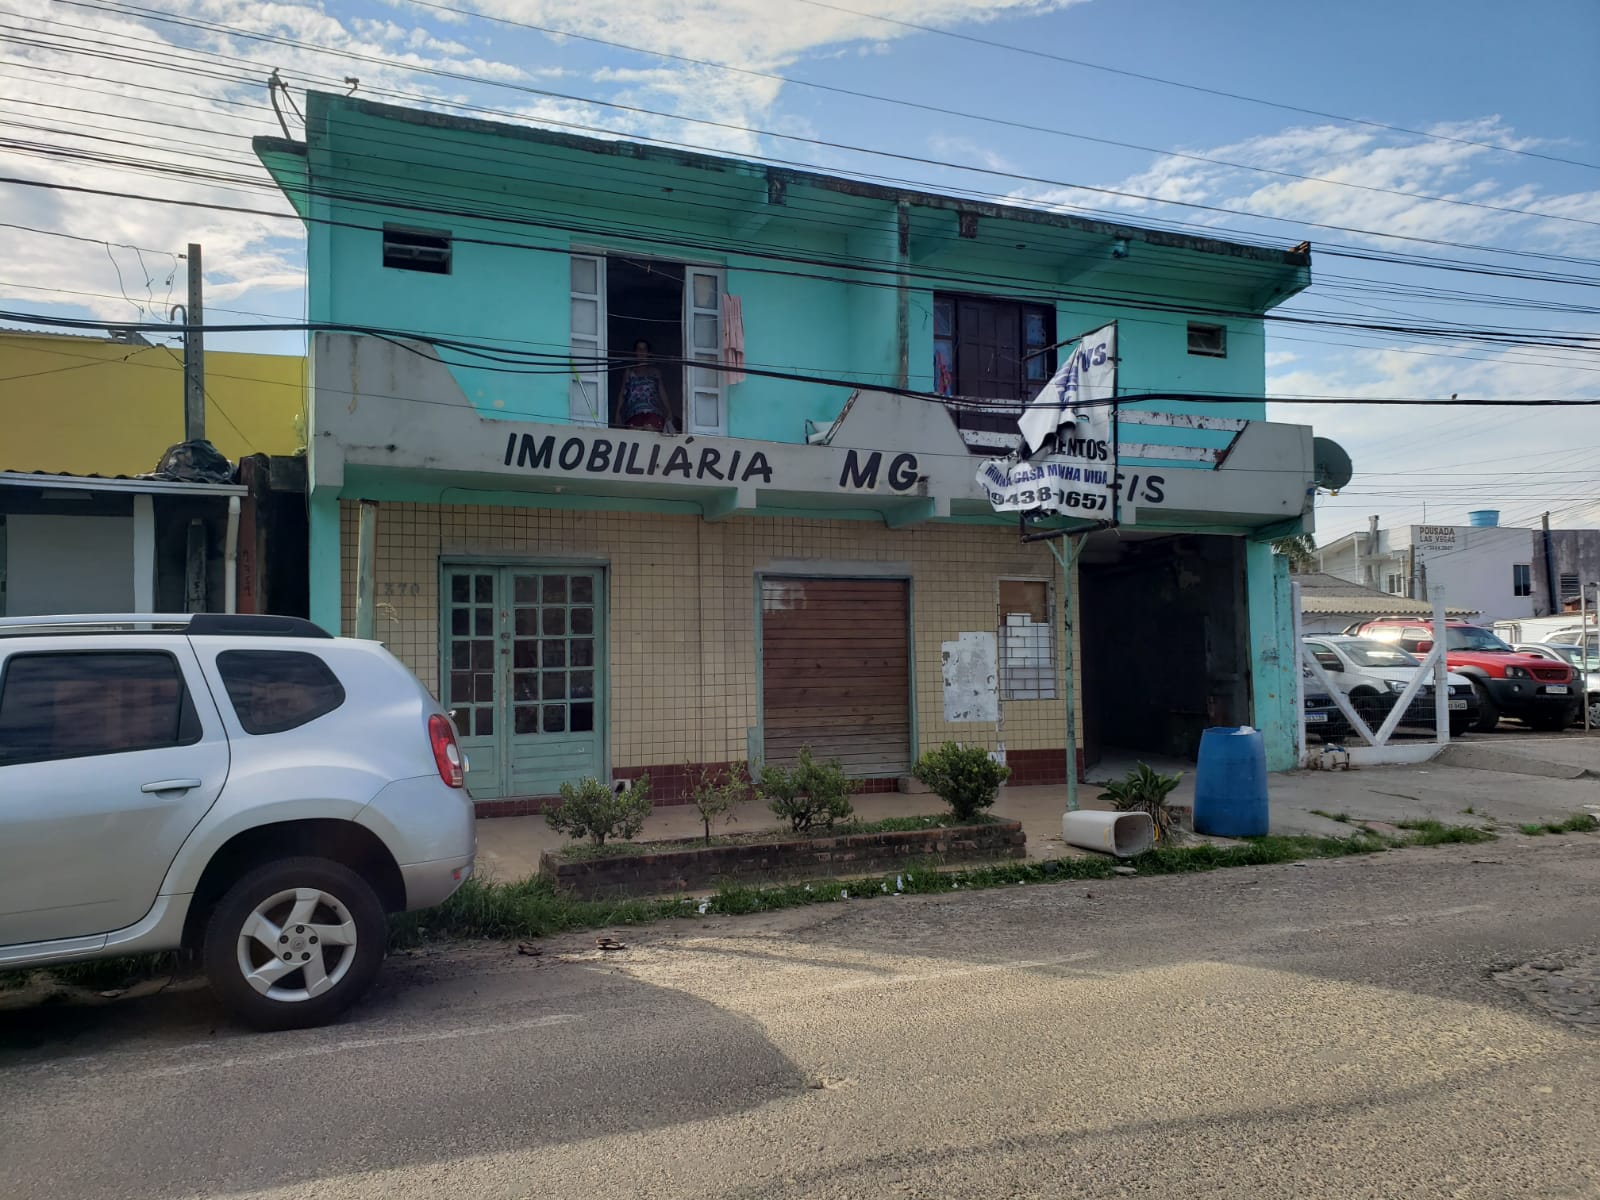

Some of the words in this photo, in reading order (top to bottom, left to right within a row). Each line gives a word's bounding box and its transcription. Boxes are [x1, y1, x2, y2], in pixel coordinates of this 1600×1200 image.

[503, 432, 773, 483] IMOBILIÁRIA
[839, 449, 918, 491] MG
[1014, 466, 1045, 484] CASA
[1083, 468, 1108, 485] VIDA
[1419, 526, 1456, 535] POUSADA
[1419, 535, 1433, 543] LAS
